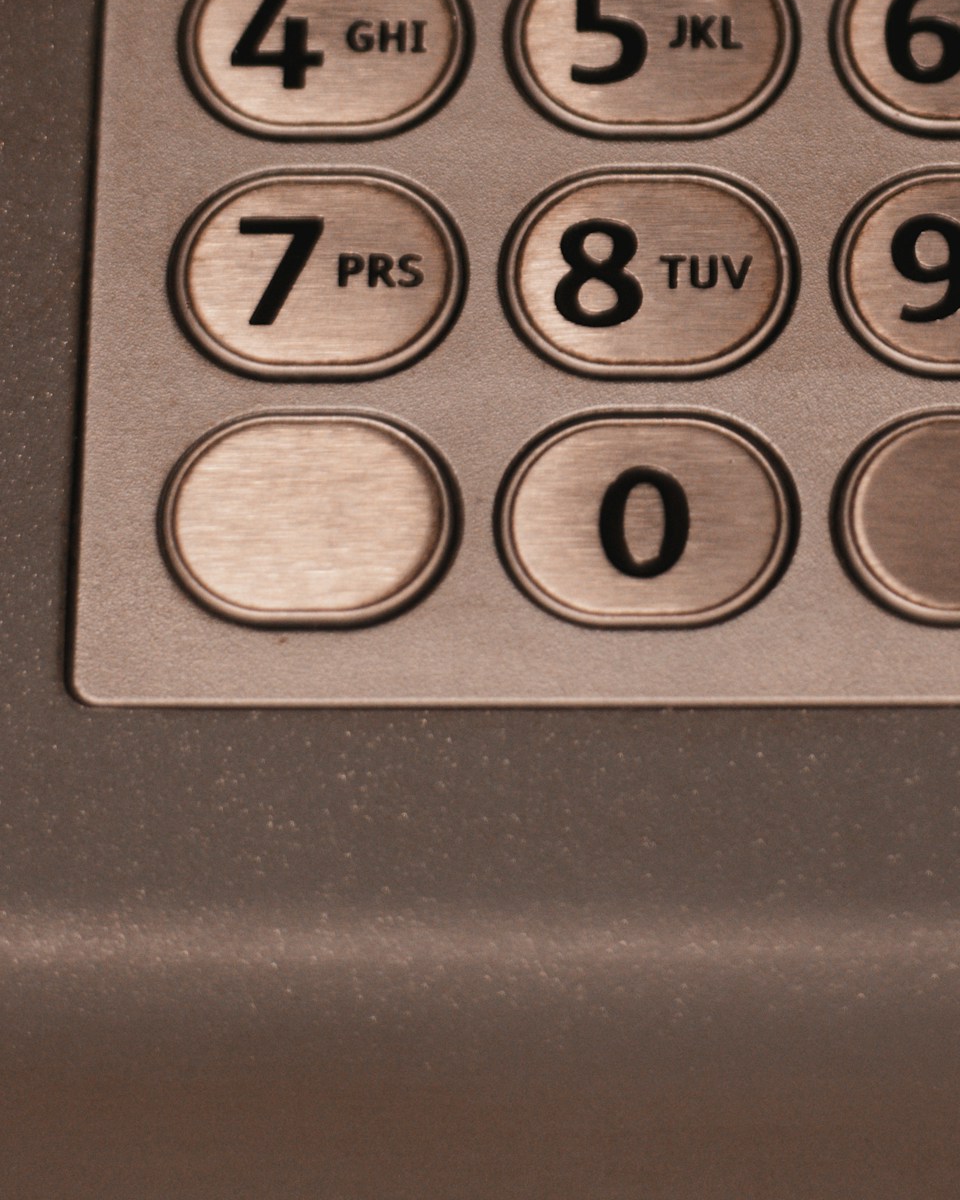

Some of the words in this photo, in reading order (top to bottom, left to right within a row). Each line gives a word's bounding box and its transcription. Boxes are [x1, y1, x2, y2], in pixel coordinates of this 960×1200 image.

[346, 19, 428, 54] GHI
[668, 15, 744, 50] JKL
[239, 216, 325, 326] 7
[337, 252, 425, 288] PRS
[553, 217, 644, 328] 8
[660, 254, 754, 289] TUV
[599, 464, 690, 579] 0
